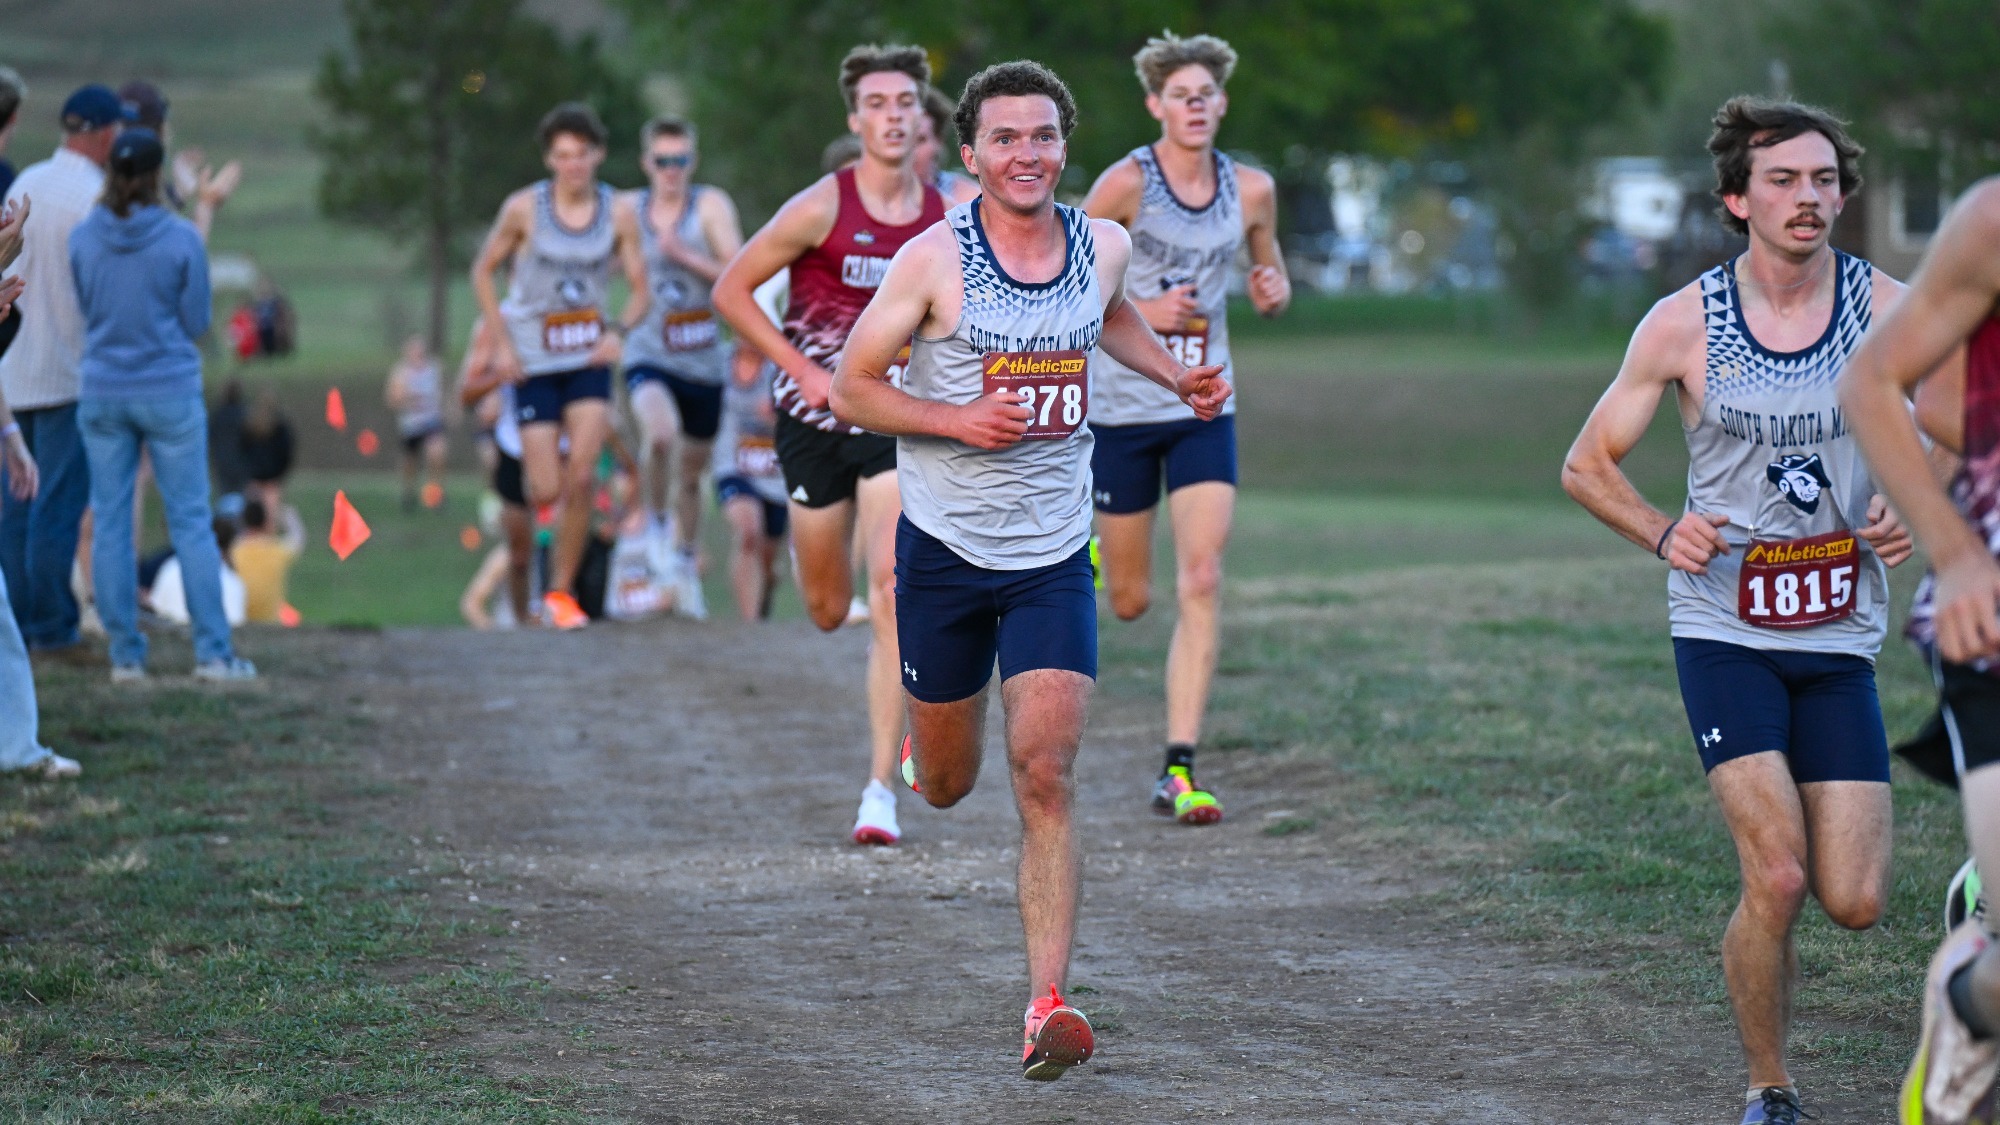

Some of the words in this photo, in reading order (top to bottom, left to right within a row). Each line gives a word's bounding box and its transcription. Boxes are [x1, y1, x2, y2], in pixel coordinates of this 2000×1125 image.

[969, 324, 1009, 356] SOUTH
[986, 356, 1060, 375] Athletic
[1062, 361, 1082, 372] NET
[996, 384, 1082, 427] 878
[1719, 404, 1764, 446] SOUTH
[1769, 410, 1823, 448] DAKOTA
[1745, 543, 1827, 564] Athletic
[1828, 541, 1851, 555] NET
[1748, 565, 1853, 617] 1815
